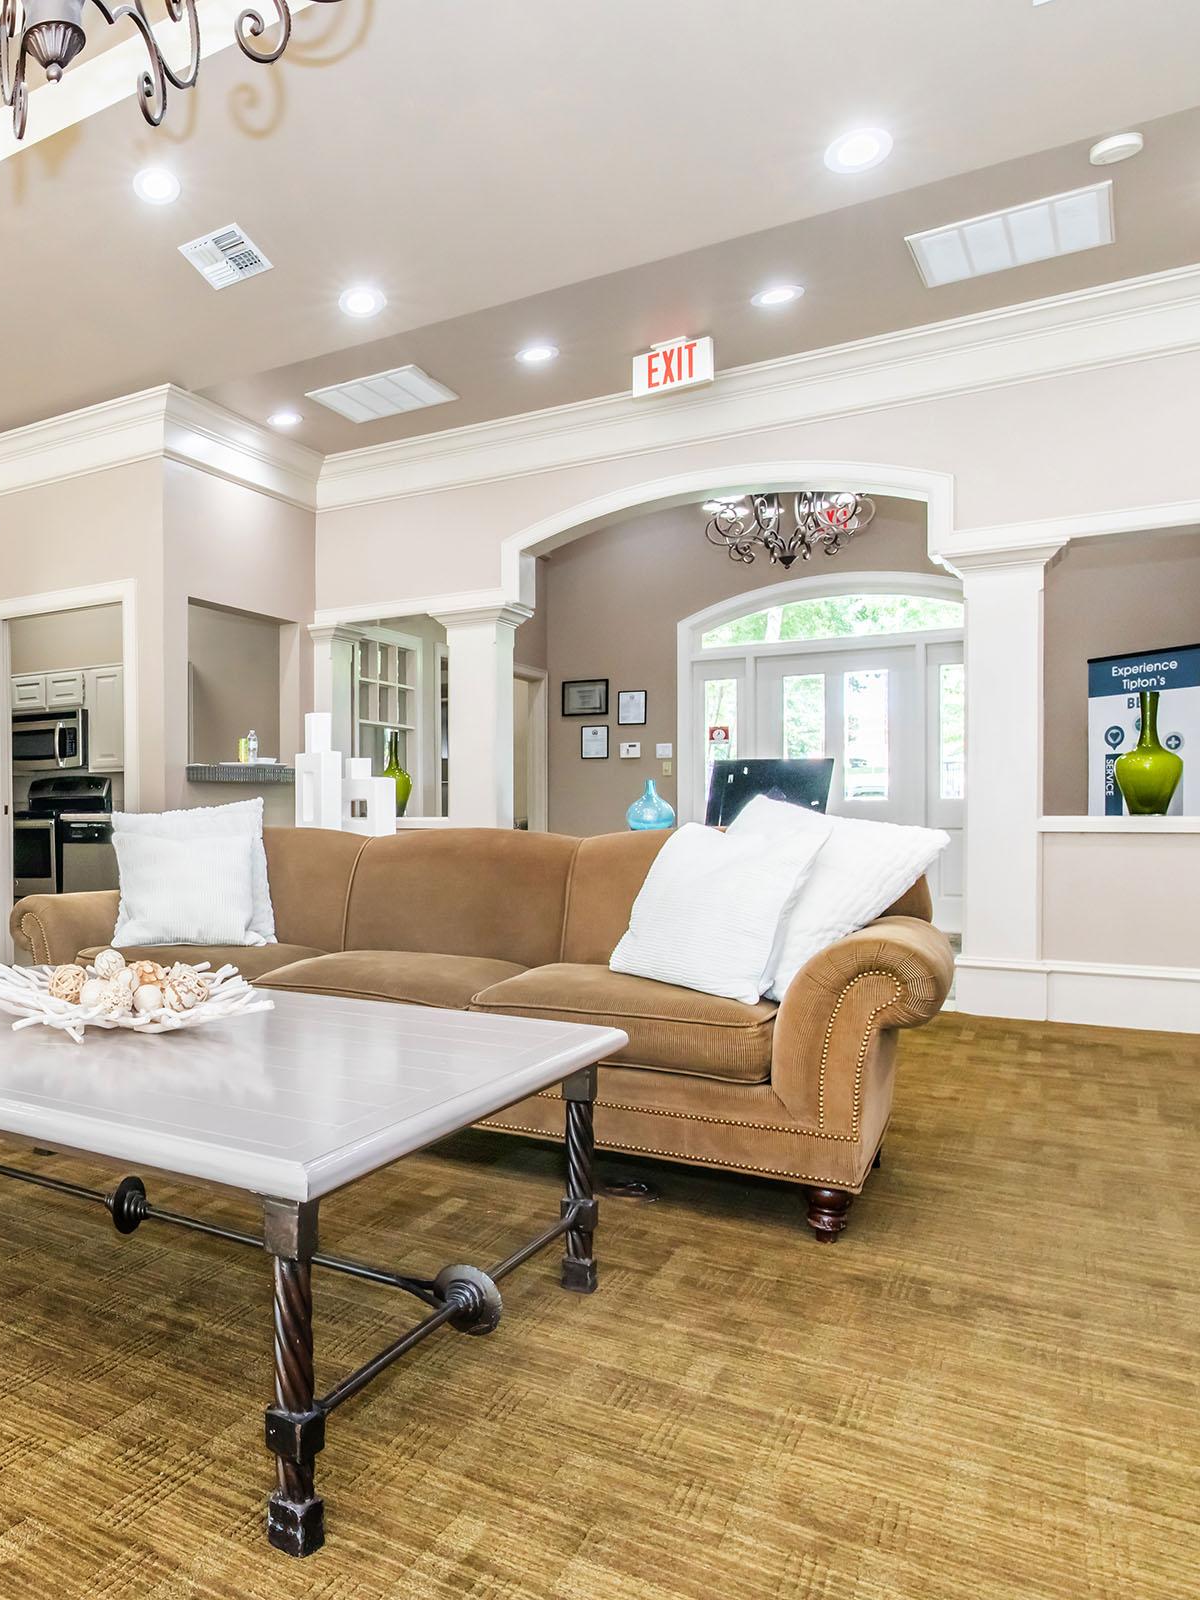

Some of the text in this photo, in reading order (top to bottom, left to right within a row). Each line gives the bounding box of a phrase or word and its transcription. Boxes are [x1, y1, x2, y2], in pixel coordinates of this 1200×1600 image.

[647, 342, 697, 389] EXIT
[1111, 660, 1178, 677] Experience
[1122, 675, 1166, 691] Tipton's
[1105, 759, 1115, 796] SERVICE
